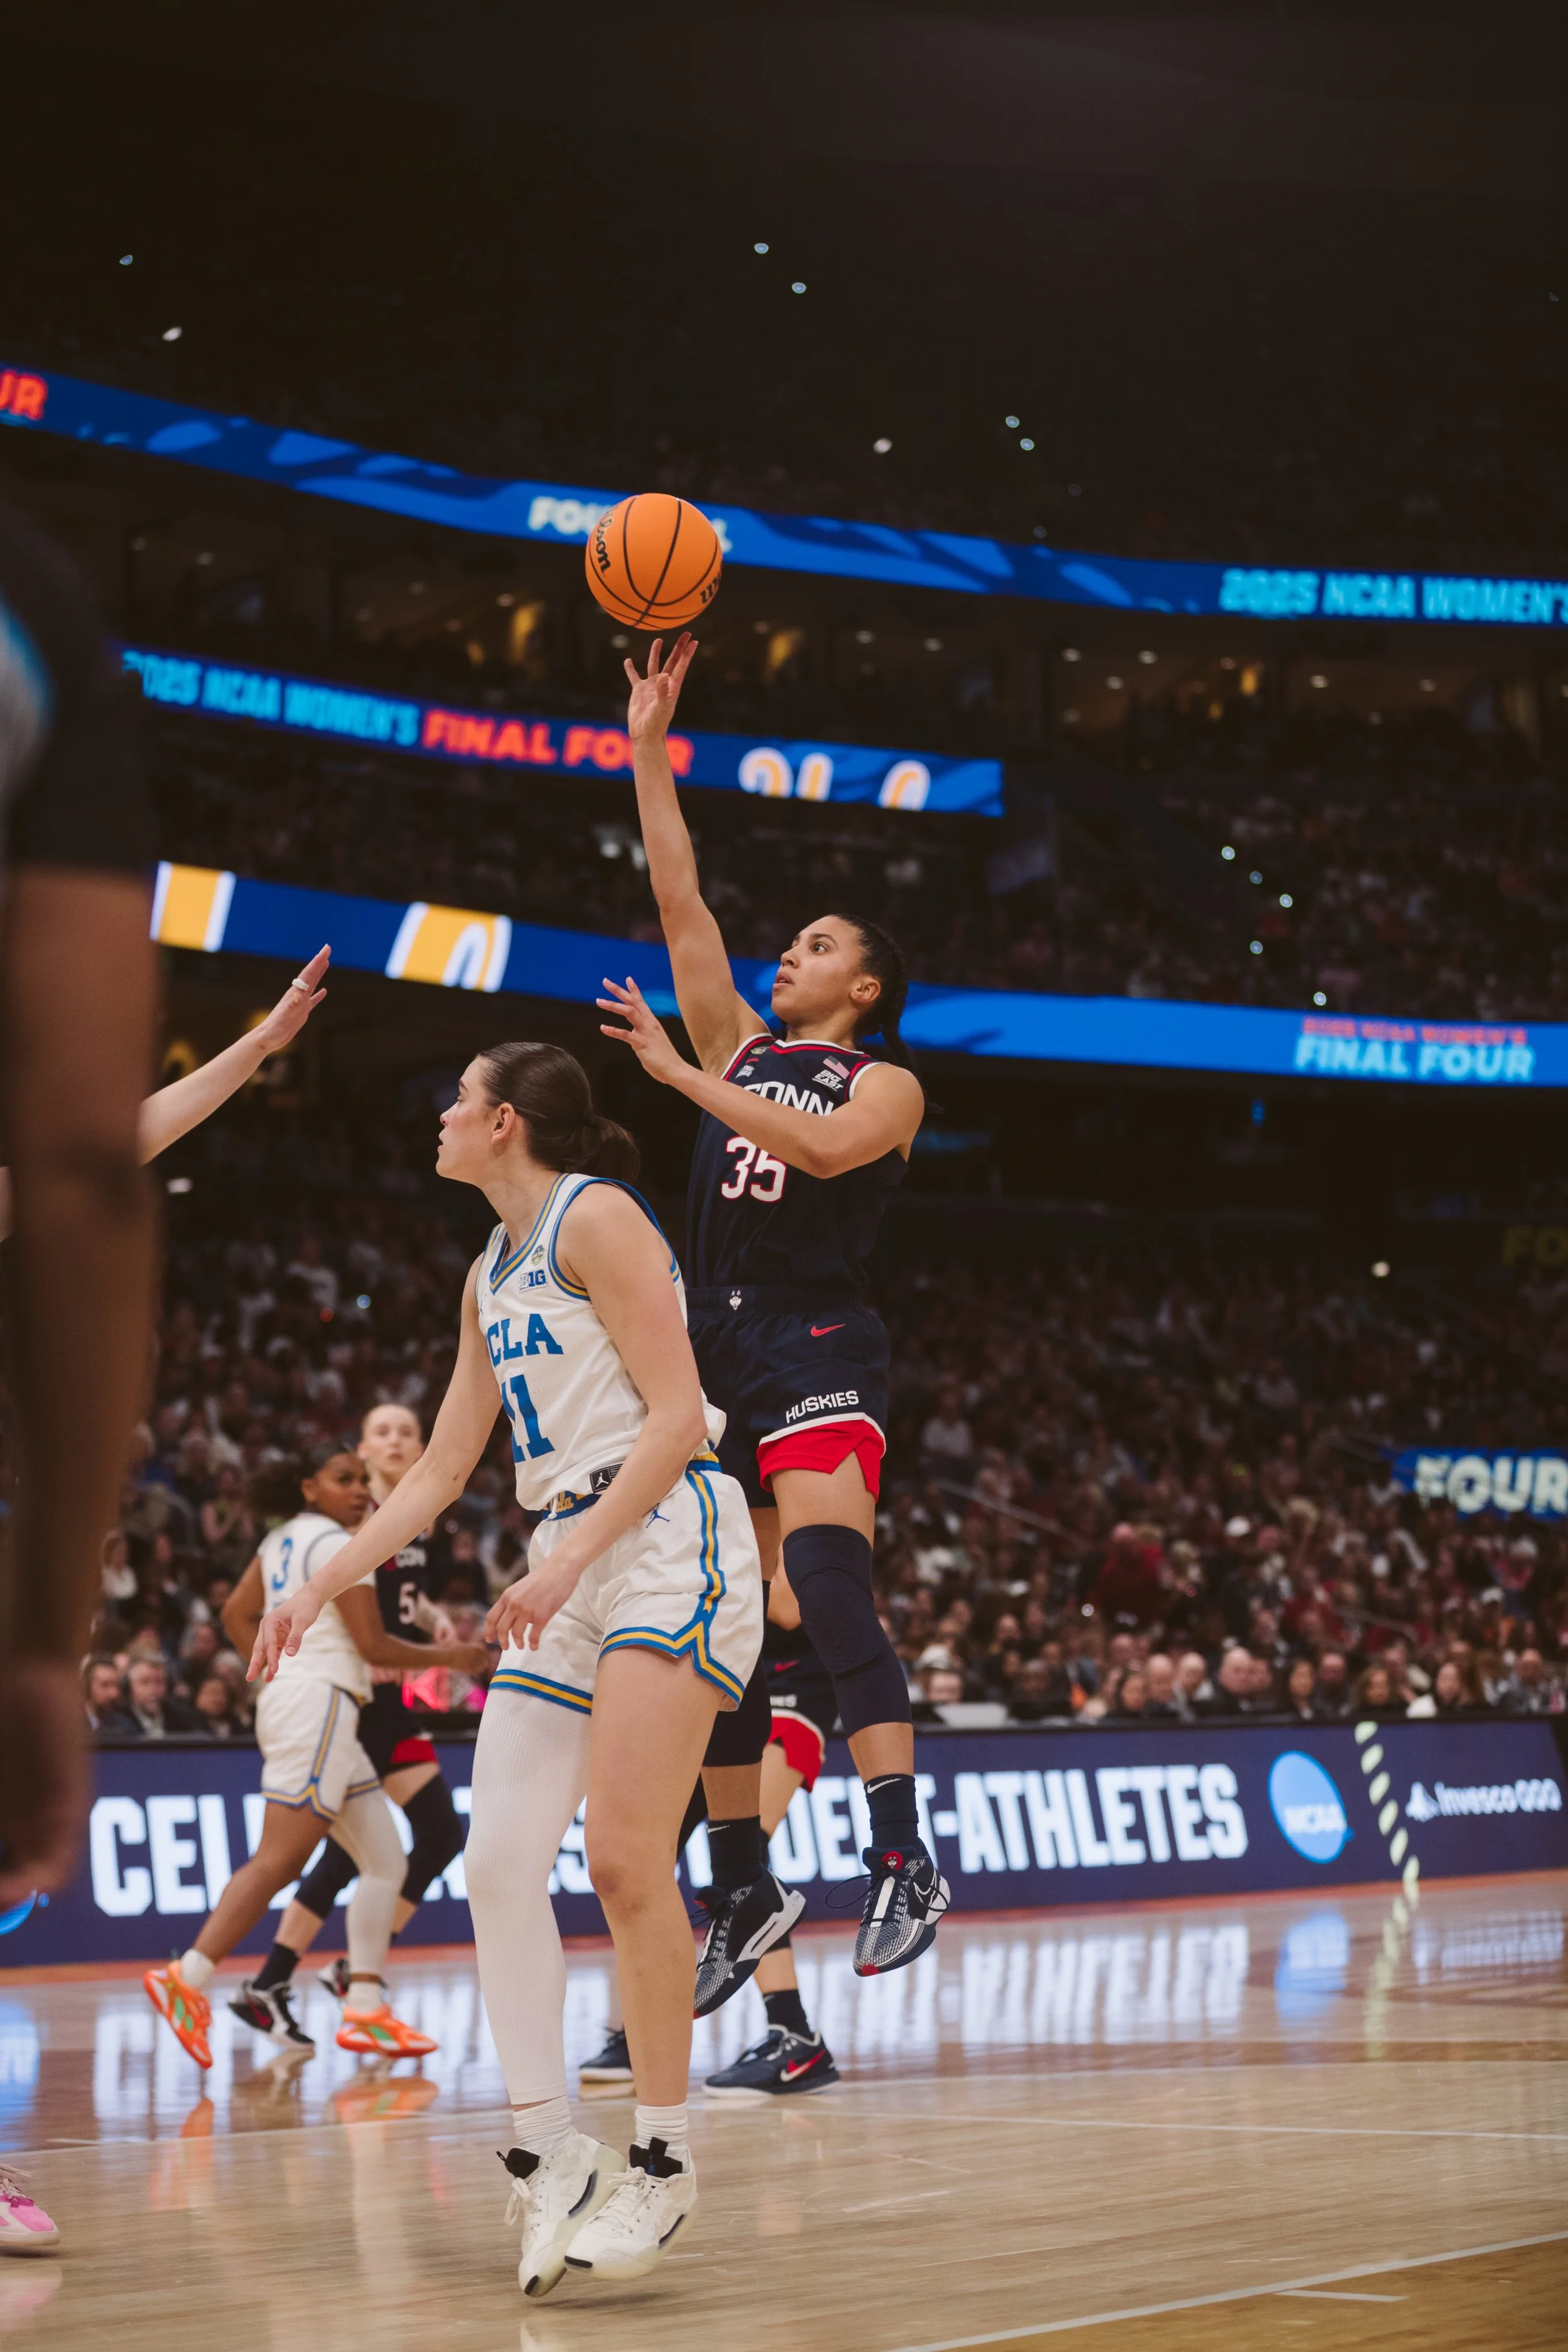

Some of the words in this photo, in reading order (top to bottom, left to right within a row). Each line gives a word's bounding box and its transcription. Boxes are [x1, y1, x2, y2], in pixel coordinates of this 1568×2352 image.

[1219, 568, 1319, 615] 2025
[1322, 573, 1416, 618] NCAA
[283, 680, 420, 747] WOMEN'S
[422, 708, 556, 765] FINAL
[564, 725, 694, 777] FOR
[815, 1073, 844, 1090] EAST
[818, 1069, 842, 1083] BIG
[1295, 1034, 1411, 1079] FINAL
[1416, 1041, 1535, 1083] FOUR
[721, 1135, 787, 1204] 35
[485, 1313, 564, 1368] CLA
[501, 1374, 556, 1464] 11
[785, 1390, 860, 1424] HUSKIES
[1414, 1454, 1568, 1514] FOUR
[272, 1536, 294, 1591] 3
[398, 1581, 417, 1624] 5
[1434, 1782, 1517, 1816] Invesco
[1513, 1777, 1563, 1813] QQQ
